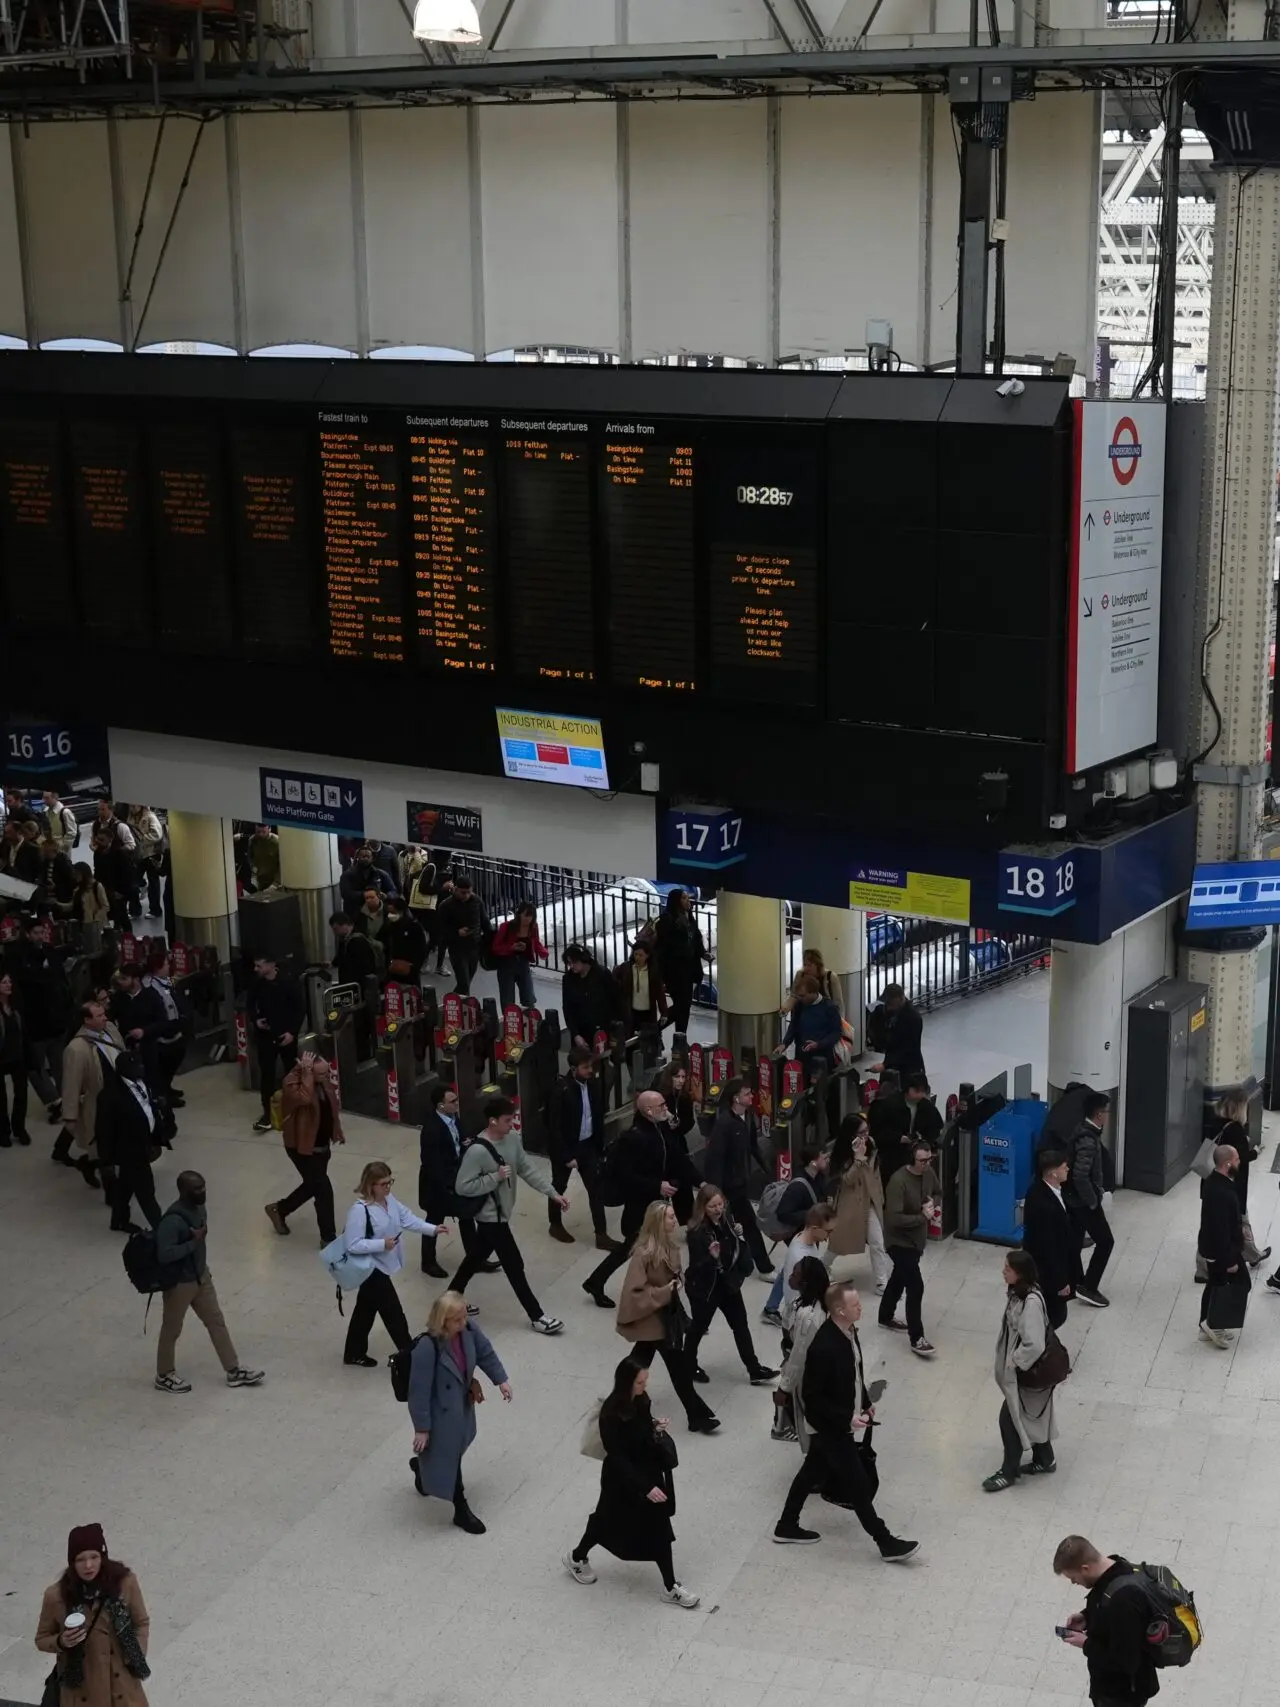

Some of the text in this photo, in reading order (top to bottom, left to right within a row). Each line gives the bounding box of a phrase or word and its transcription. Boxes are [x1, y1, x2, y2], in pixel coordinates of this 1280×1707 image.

[318, 411, 369, 423] Fastest train to
[406, 415, 489, 428] Subsequent departures
[501, 419, 589, 432] Subsequent departures
[605, 422, 655, 434] Arrivals from
[1110, 446, 1141, 456] UNDERGROUND
[1113, 510, 1150, 526] Underground
[736, 554, 748, 563] Our
[755, 566, 782, 575] seconds
[731, 575, 796, 587] prior to departure
[1112, 588, 1148, 607] Underground
[761, 618, 773, 626] and
[756, 629, 769, 637] run
[444, 658, 465, 669] Page
[477, 661, 487, 670] of
[540, 667, 562, 678] Page
[574, 670, 584, 679] of
[639, 677, 662, 688] Page
[675, 681, 685, 689] of
[500, 713, 559, 731] INDUSTRIAL
[562, 721, 598, 735] ACTION
[8, 733, 34, 759] 16
[42, 730, 72, 758] 16
[267, 803, 335, 821] Wide Platform Gate
[455, 814, 480, 829] WiFi
[676, 822, 709, 851] 17
[720, 818, 742, 851] 17
[868, 869, 899, 879] WARNING
[1056, 861, 1074, 897] 18
[1006, 866, 1045, 898] 18
[236, 1019, 247, 1057] KFC
[388, 1072, 400, 1113] KFC
[983, 1136, 1009, 1147] METRO
